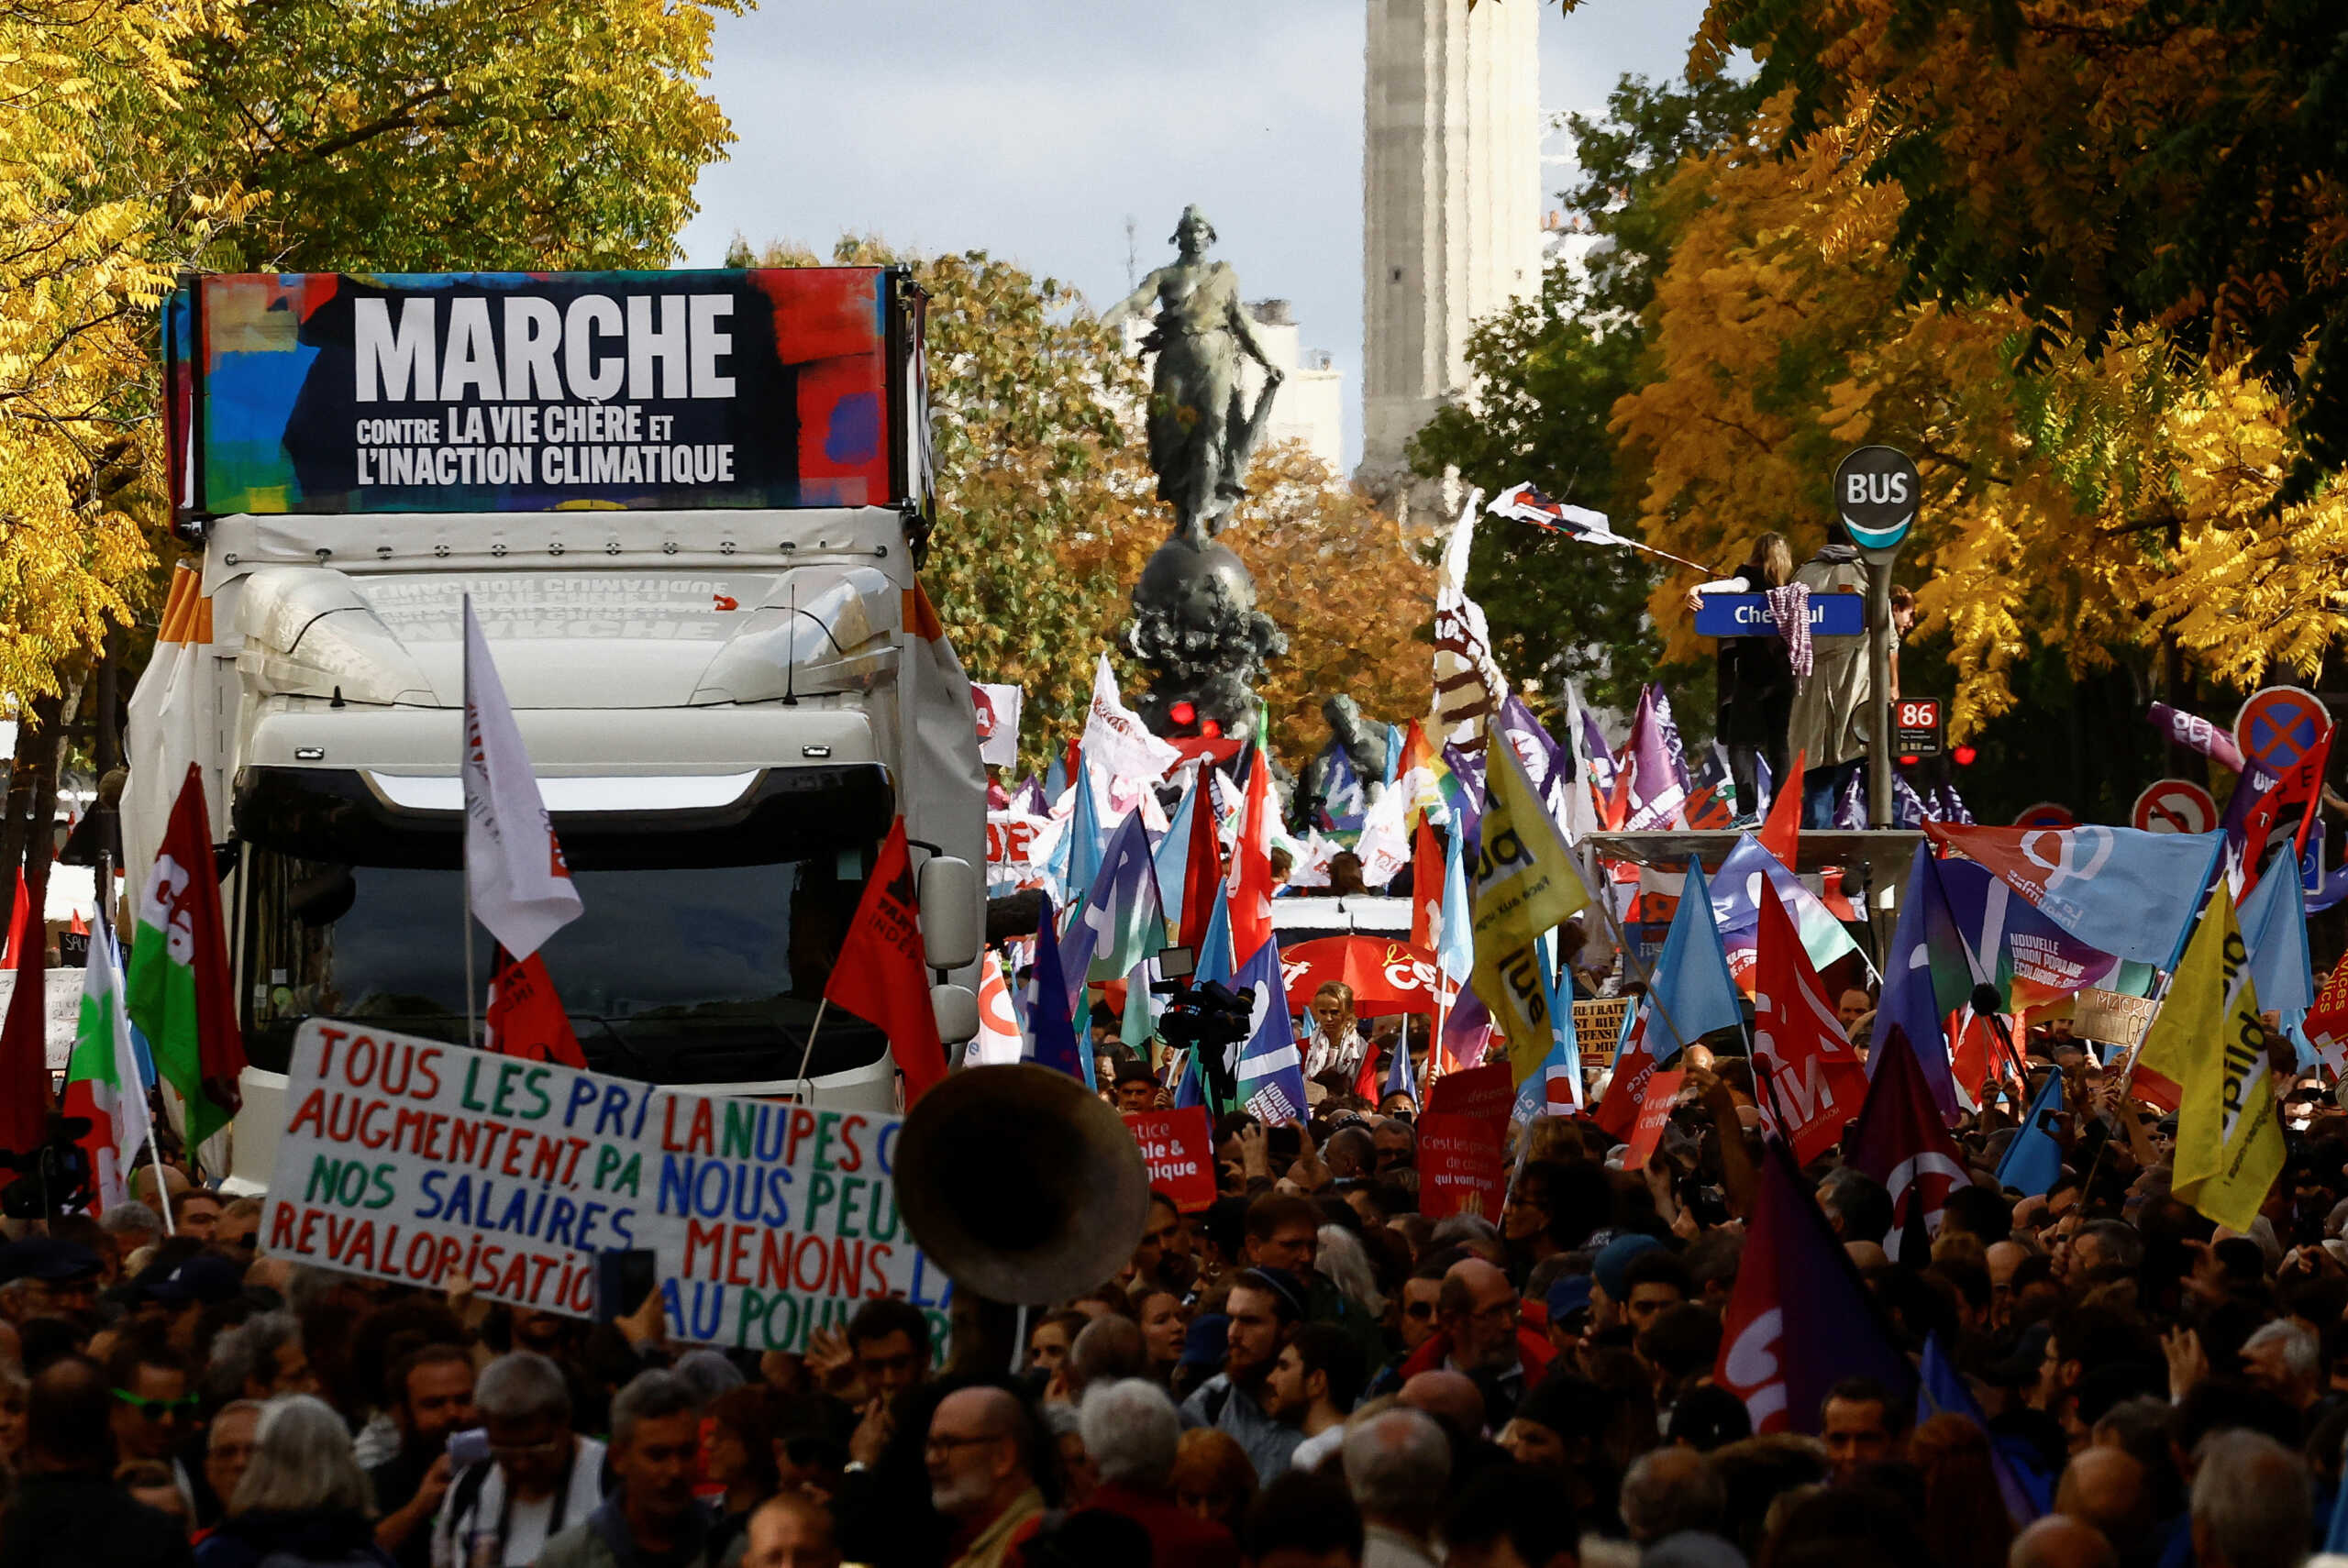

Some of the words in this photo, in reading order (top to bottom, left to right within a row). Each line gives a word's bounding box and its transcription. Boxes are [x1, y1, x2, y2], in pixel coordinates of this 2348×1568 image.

[354, 293, 736, 402] MARCHE
[356, 418, 440, 444] CONTRE
[448, 406, 484, 442] LA
[490, 406, 541, 442] VIE
[544, 397, 643, 442] CHÈRE
[649, 415, 674, 441] ET
[357, 447, 535, 485] L'INACTION
[541, 444, 735, 485] CLIMATIQUE
[1846, 472, 1908, 505] BUS
[1734, 605, 1824, 624] Cheul
[1902, 703, 1933, 726] 86
[2010, 933, 2059, 955] NOUVELLE
[2012, 946, 2041, 966] UNION
[318, 1026, 444, 1100] TOUS
[461, 1056, 552, 1120] LES
[564, 1077, 656, 1140] PRI
[662, 1095, 714, 1157] LA
[722, 1101, 869, 1172] NUPES
[1169, 1138, 1185, 1156] &
[305, 1154, 397, 1209] NOS
[593, 1144, 642, 1198] PA
[658, 1154, 792, 1228] NOUS
[803, 1172, 904, 1243] PEU
[661, 1277, 724, 1341] AU
